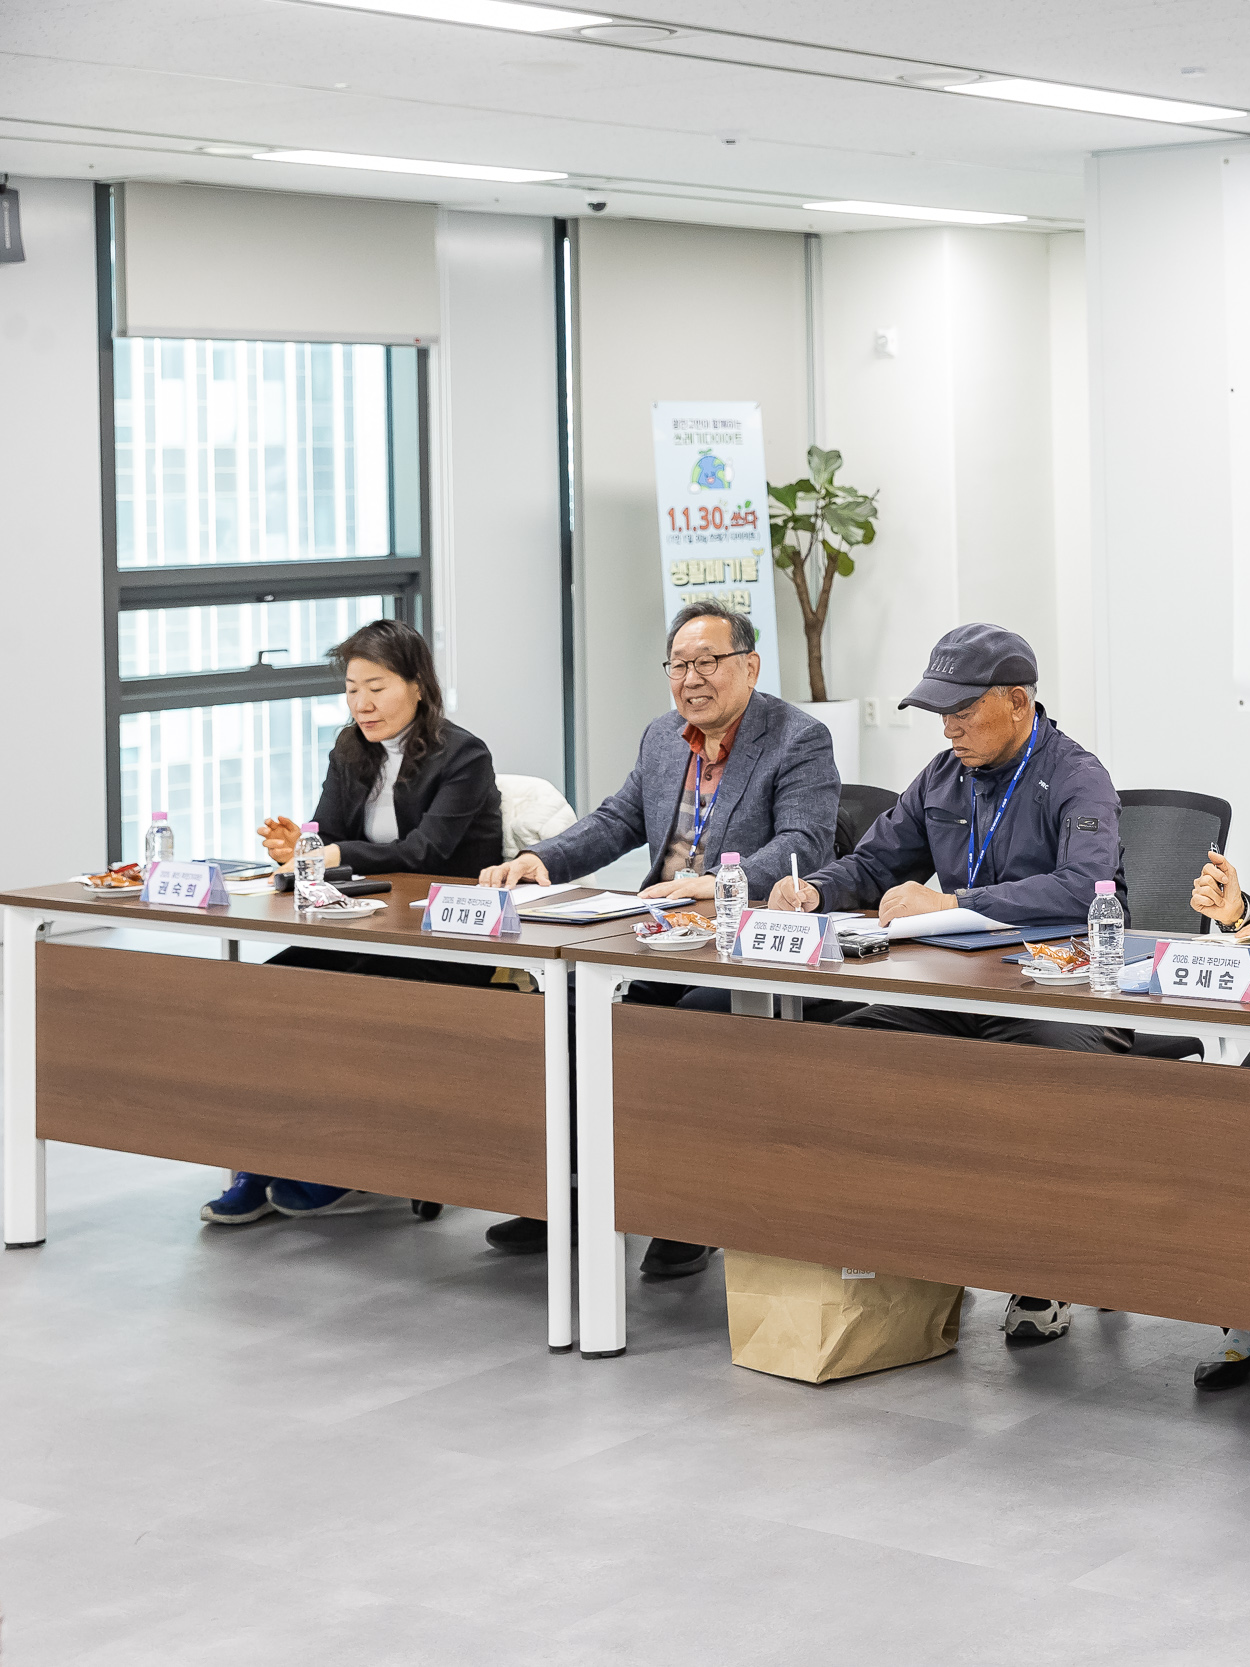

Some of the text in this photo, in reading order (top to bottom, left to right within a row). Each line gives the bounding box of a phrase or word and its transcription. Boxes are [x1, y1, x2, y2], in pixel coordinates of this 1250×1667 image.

[769, 922, 782, 931] 광진
[782, 923, 811, 934] 주민기자단
[1191, 956, 1206, 965] 광진
[1206, 957, 1241, 968] 주민기자단
